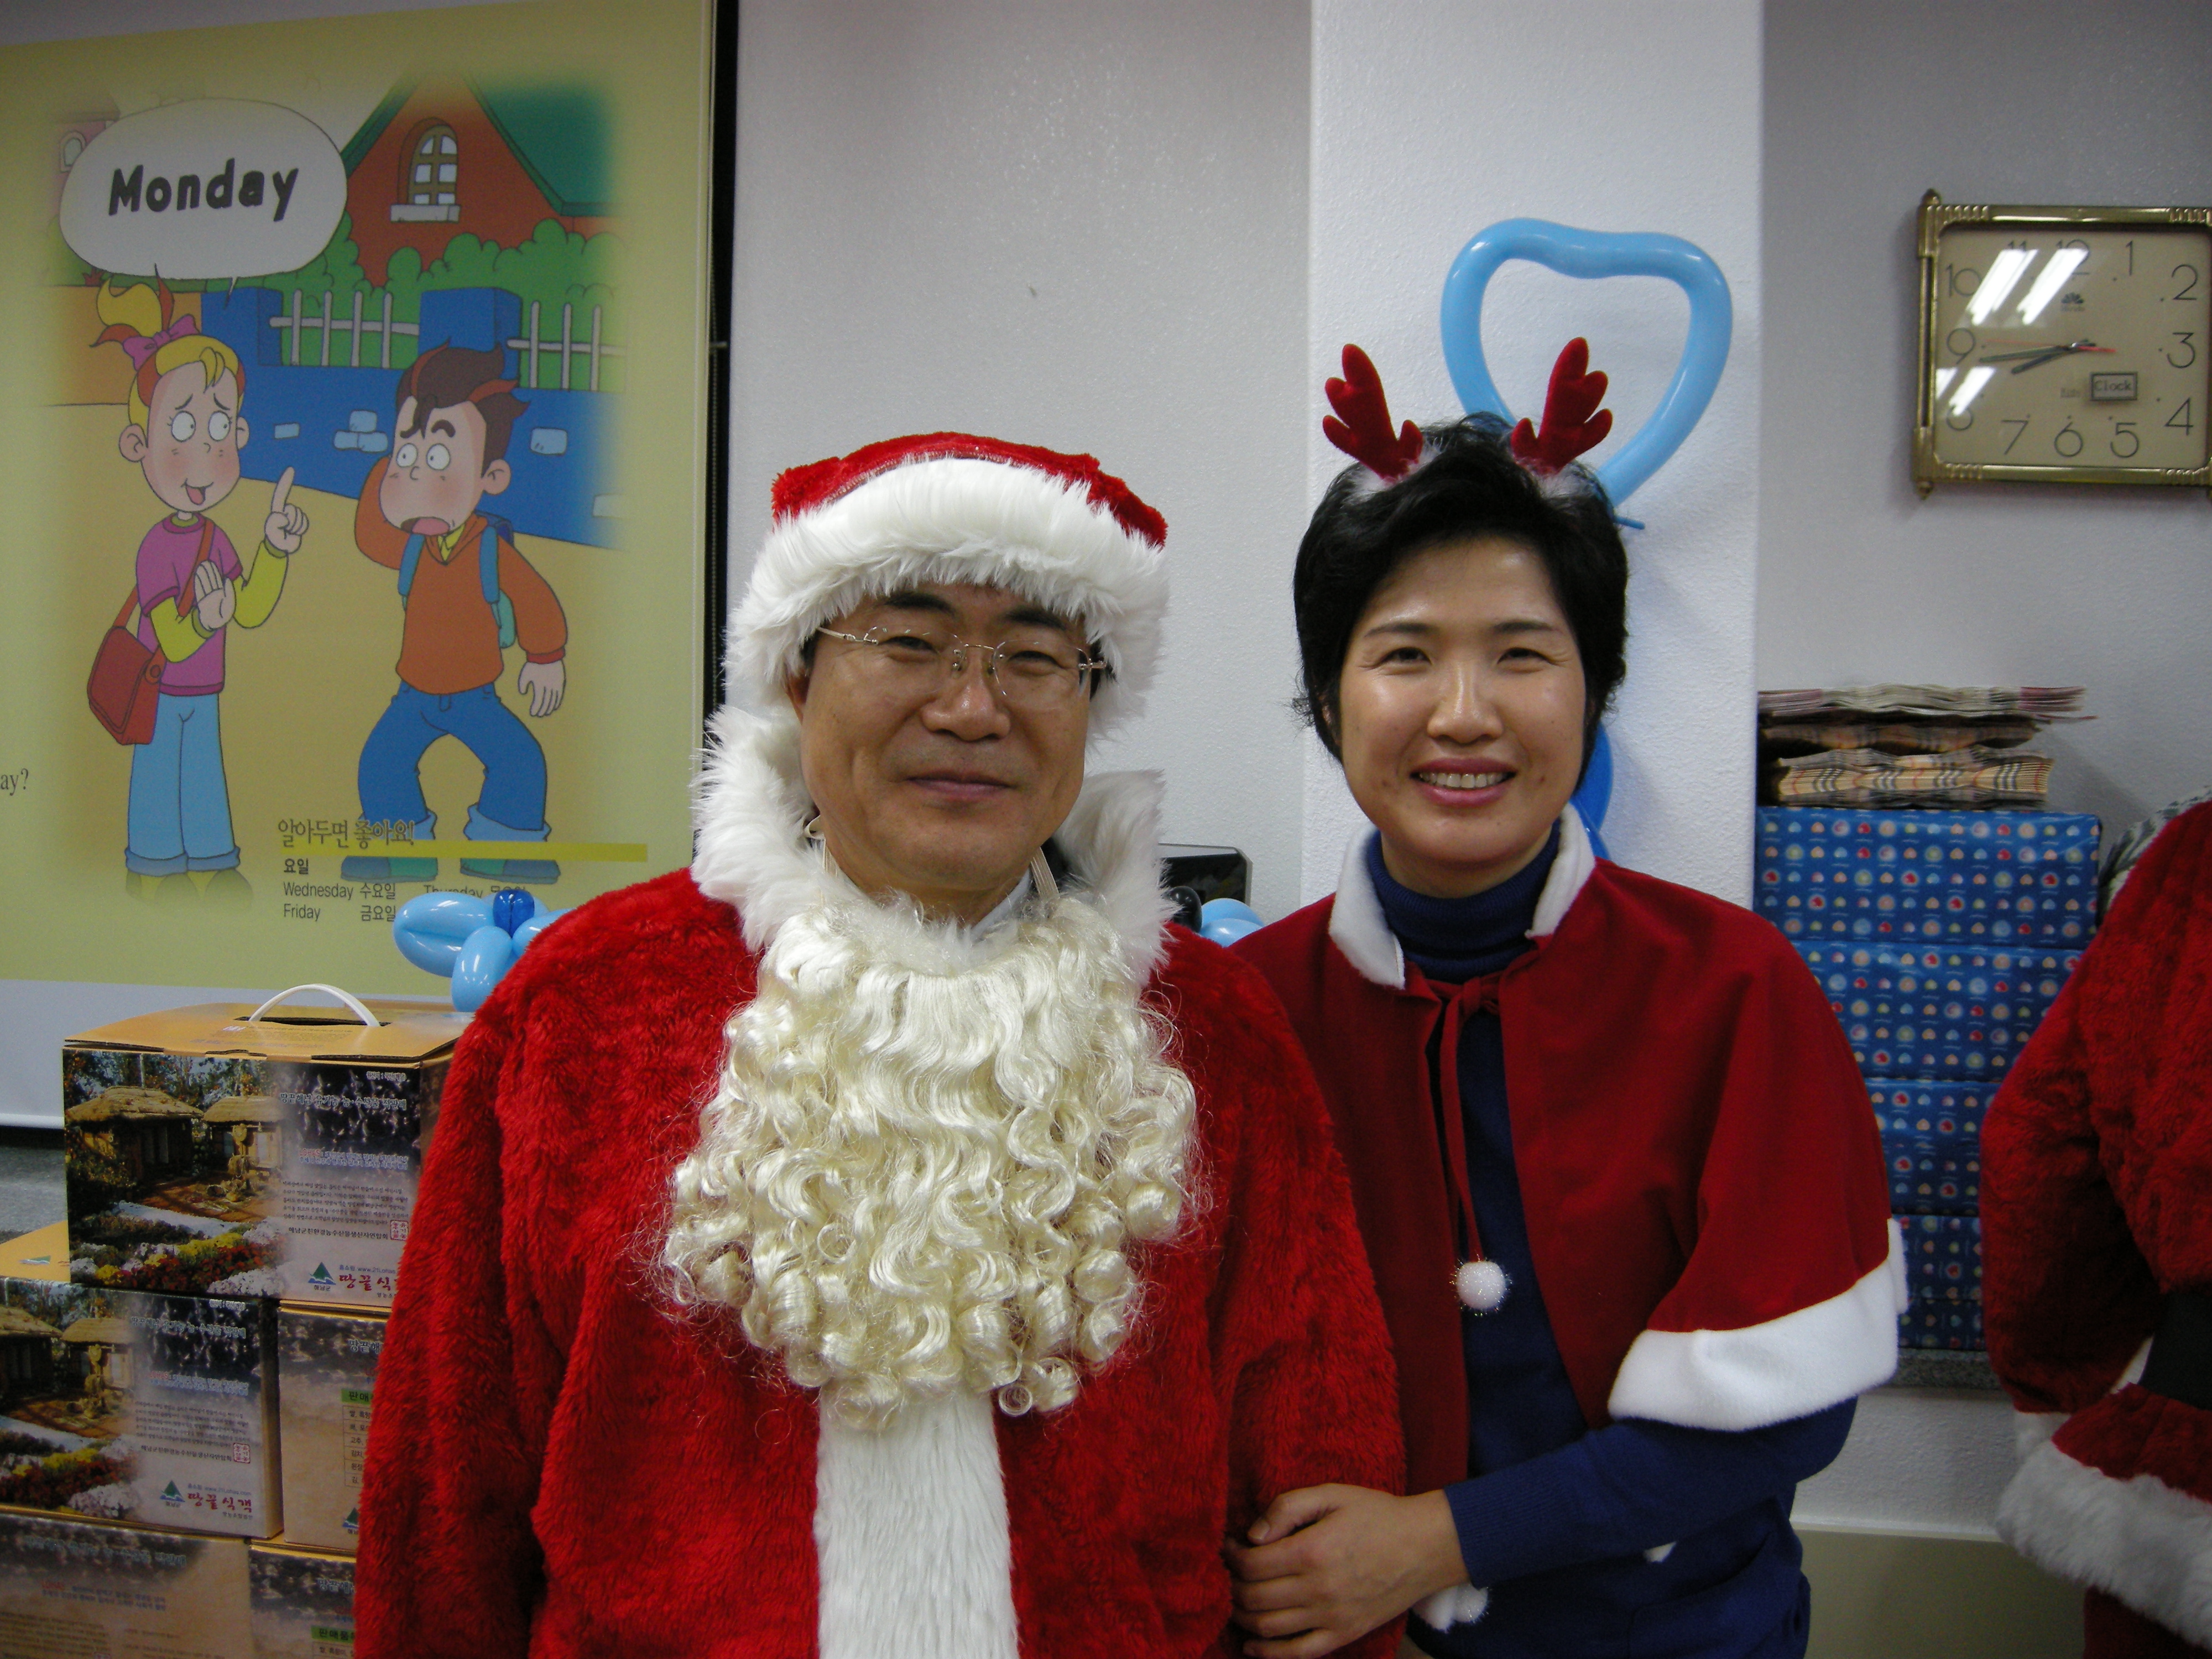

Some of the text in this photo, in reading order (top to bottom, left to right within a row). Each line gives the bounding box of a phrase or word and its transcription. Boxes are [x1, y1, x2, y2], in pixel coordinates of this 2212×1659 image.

[109, 158, 299, 222] Monday
[2126, 241, 2133, 276] 1
[1945, 264, 1982, 298] 10
[2171, 264, 2198, 301] 2
[1946, 327, 1976, 364] 9
[2167, 332, 2195, 369] 3
[2094, 379, 2132, 392] Clock
[2165, 397, 2194, 436] 4
[2001, 420, 2029, 455] 7
[2054, 421, 2084, 457] 6
[2110, 422, 2140, 458] 5
[278, 818, 415, 849] 알아두면 좋아요!
[283, 858, 310, 875] 요일
[283, 881, 353, 900] Wednesday
[359, 883, 397, 900] 수요일
[283, 903, 397, 922] Friday 금요일
[338, 1273, 397, 1291] 땅끝식
[347, 1339, 383, 1355] 땅끝해
